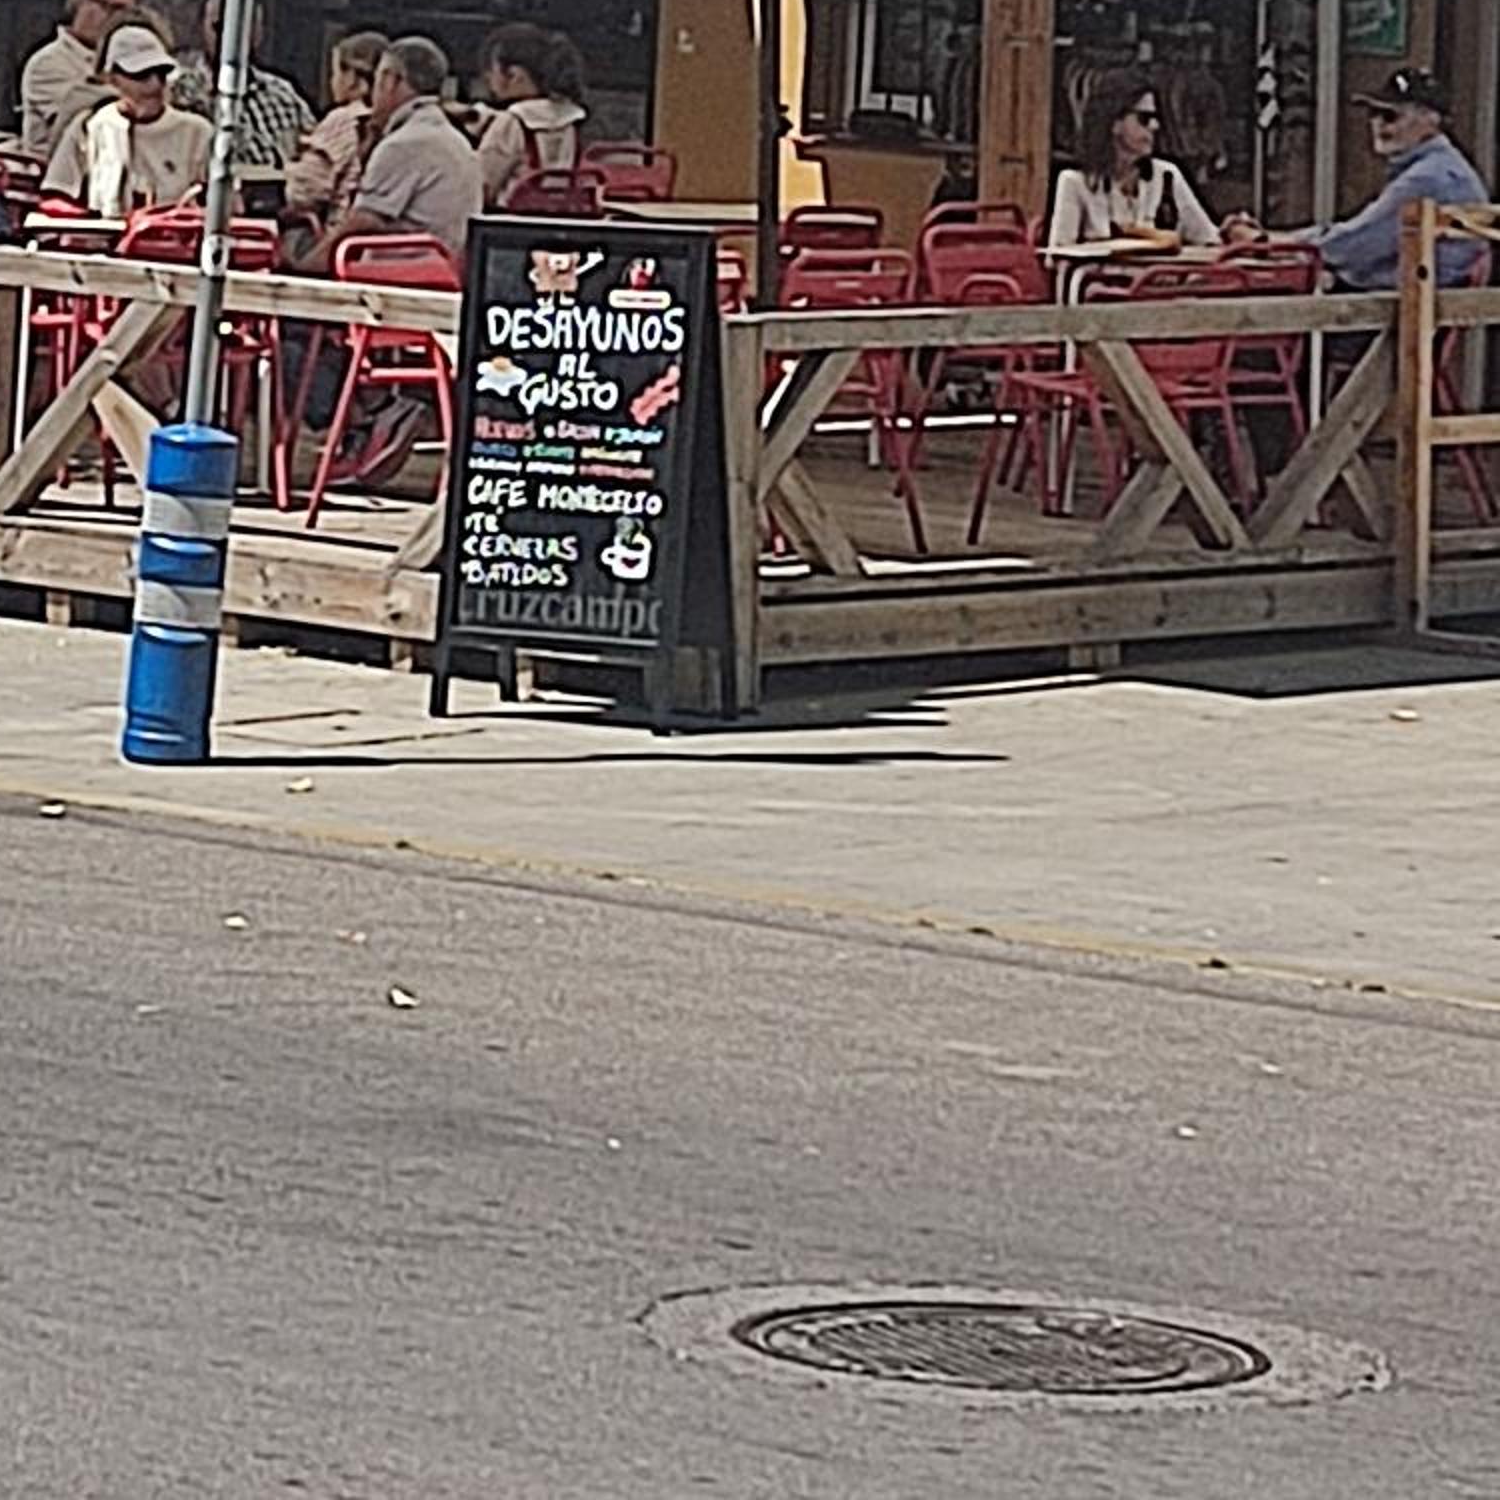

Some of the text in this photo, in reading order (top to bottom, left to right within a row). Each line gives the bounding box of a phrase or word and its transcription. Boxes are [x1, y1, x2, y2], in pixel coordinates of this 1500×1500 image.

[486, 304, 685, 352] DESAYUNOS
[558, 352, 597, 379] AL
[518, 372, 619, 415] GUSTO
[461, 560, 568, 587] BATIDOS
